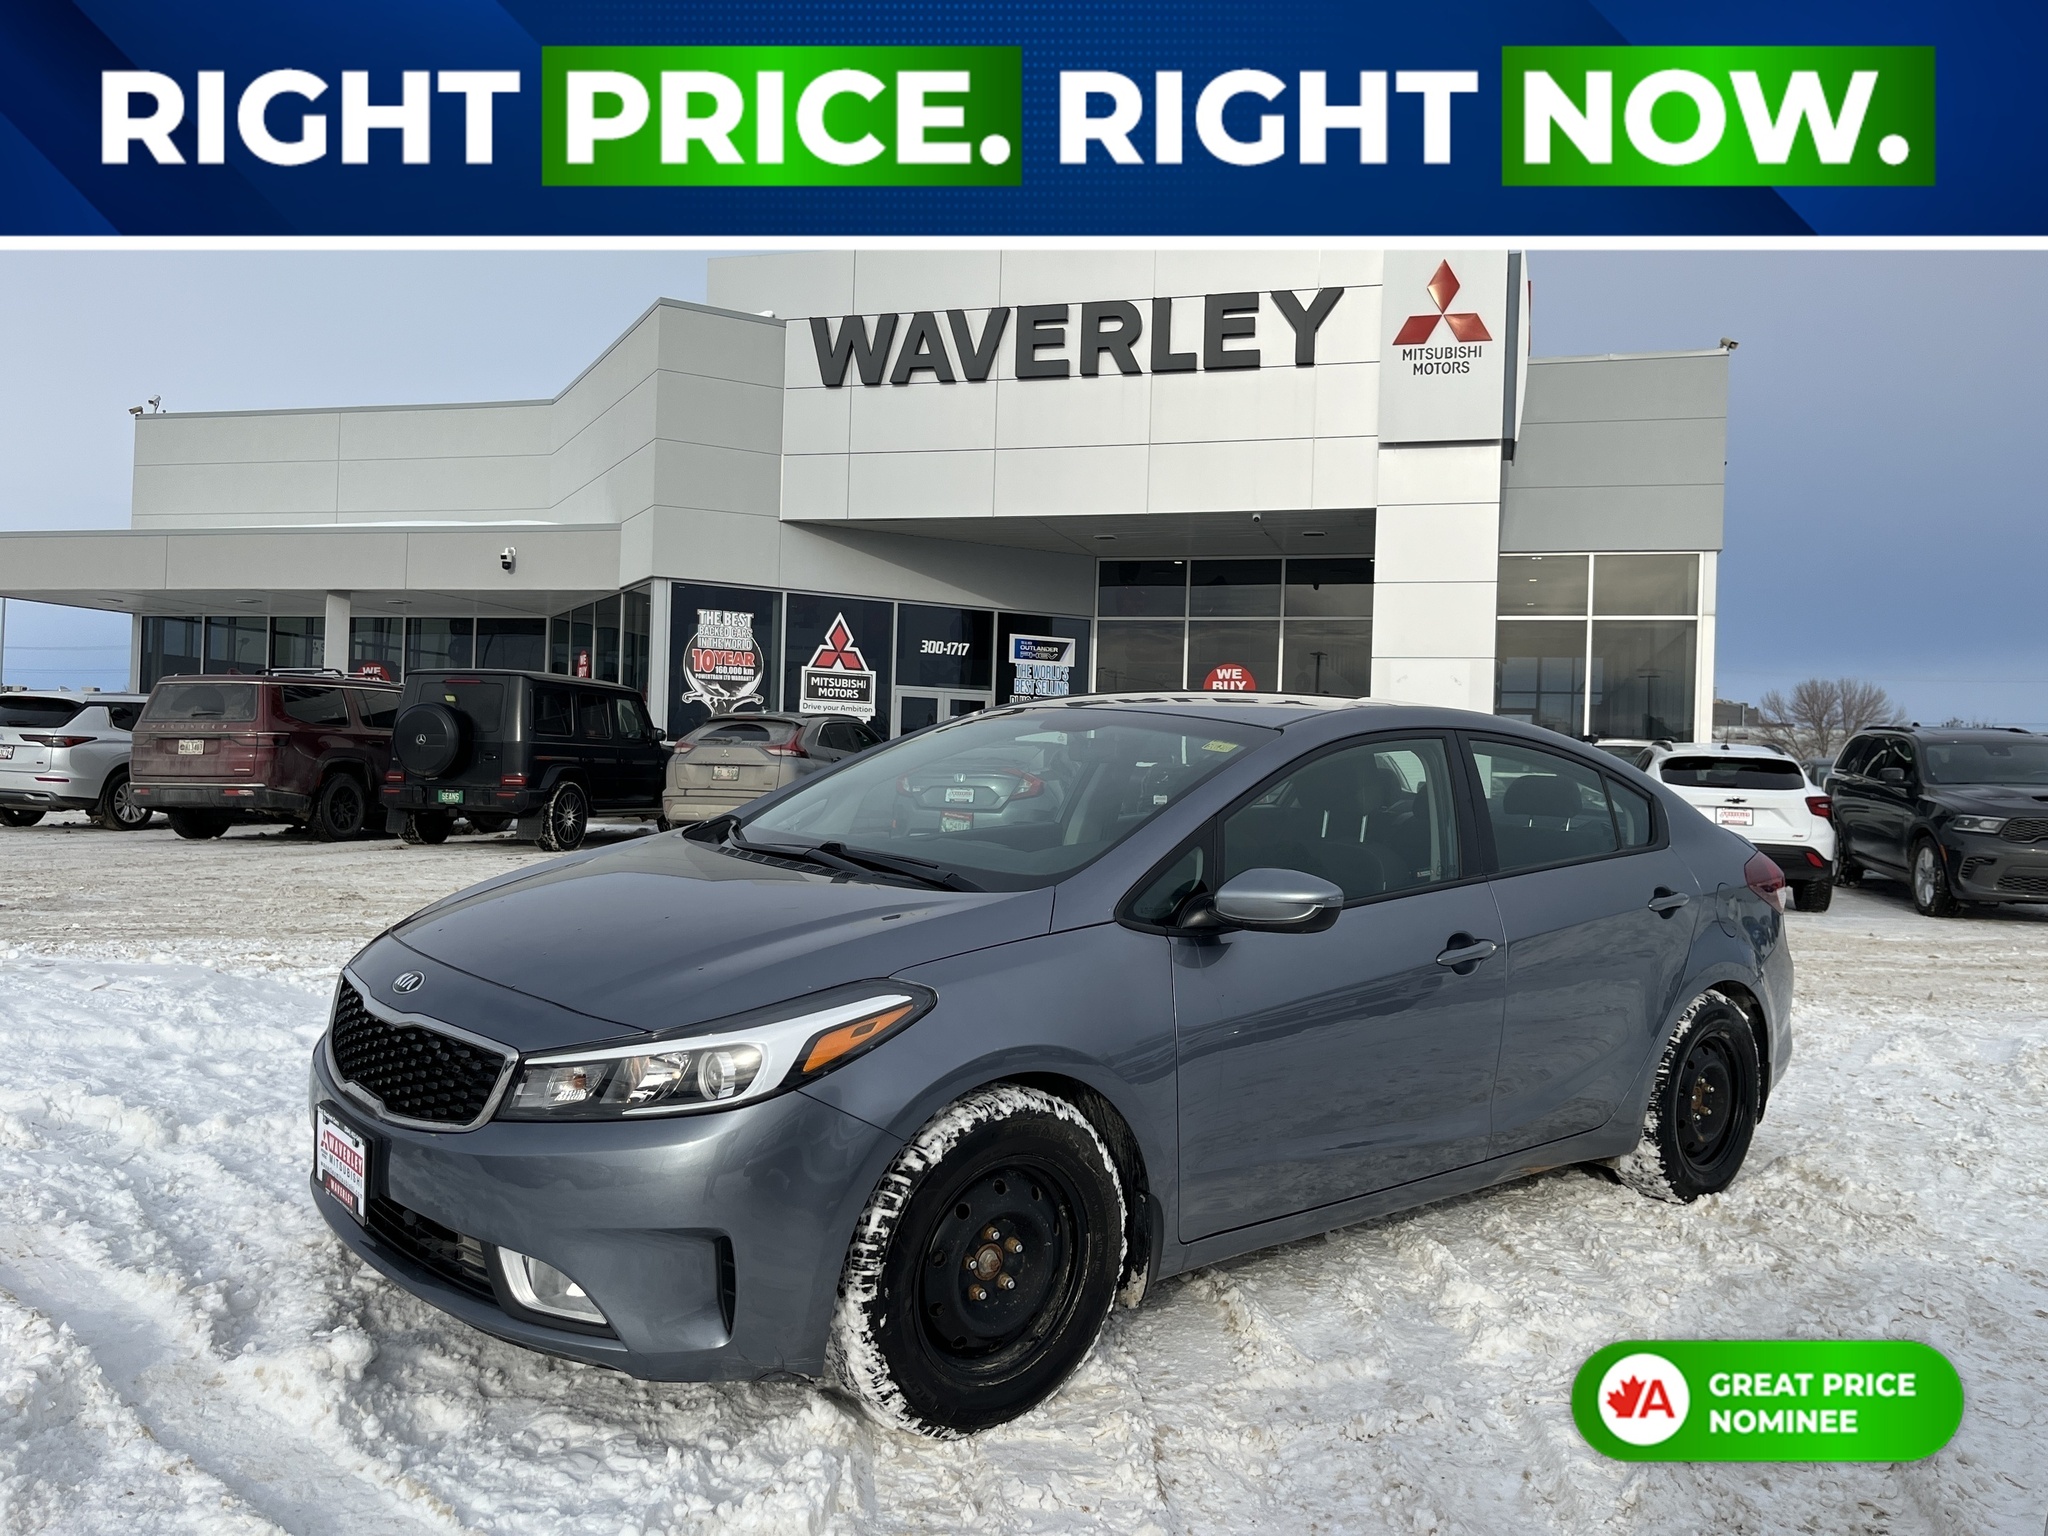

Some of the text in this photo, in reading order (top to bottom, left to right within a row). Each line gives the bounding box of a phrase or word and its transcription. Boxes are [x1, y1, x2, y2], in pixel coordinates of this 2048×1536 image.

[809, 287, 1345, 387] WAVERLEY
[1402, 346, 1482, 361] MITSUBISHI
[1413, 361, 1470, 375] MOTORS
[698, 610, 754, 628] THE BEST
[699, 625, 753, 639] BACKED CARS
[698, 637, 752, 650] IN THE WORLD
[920, 640, 970, 656] 300-1717
[1020, 645, 1058, 653] OUTLANDER
[692, 648, 755, 673] 10 YEAR
[362, 666, 381, 675] WE
[743, 667, 754, 675] km
[1016, 663, 1069, 681] THE WORLD'S
[1216, 668, 1243, 679] WE
[811, 676, 867, 689] MITSUBISHI
[1014, 678, 1069, 696] BEST SELLING
[1212, 681, 1247, 690] BUY
[818, 688, 859, 698] MOTORS
[840, 705, 873, 713] Ambition
[394, 972, 419, 991] KIA
[328, 1134, 363, 1176] WAVERLEY
[328, 1154, 363, 1189] MITSUBISHI
[330, 1179, 354, 1207] WAVERLEY
